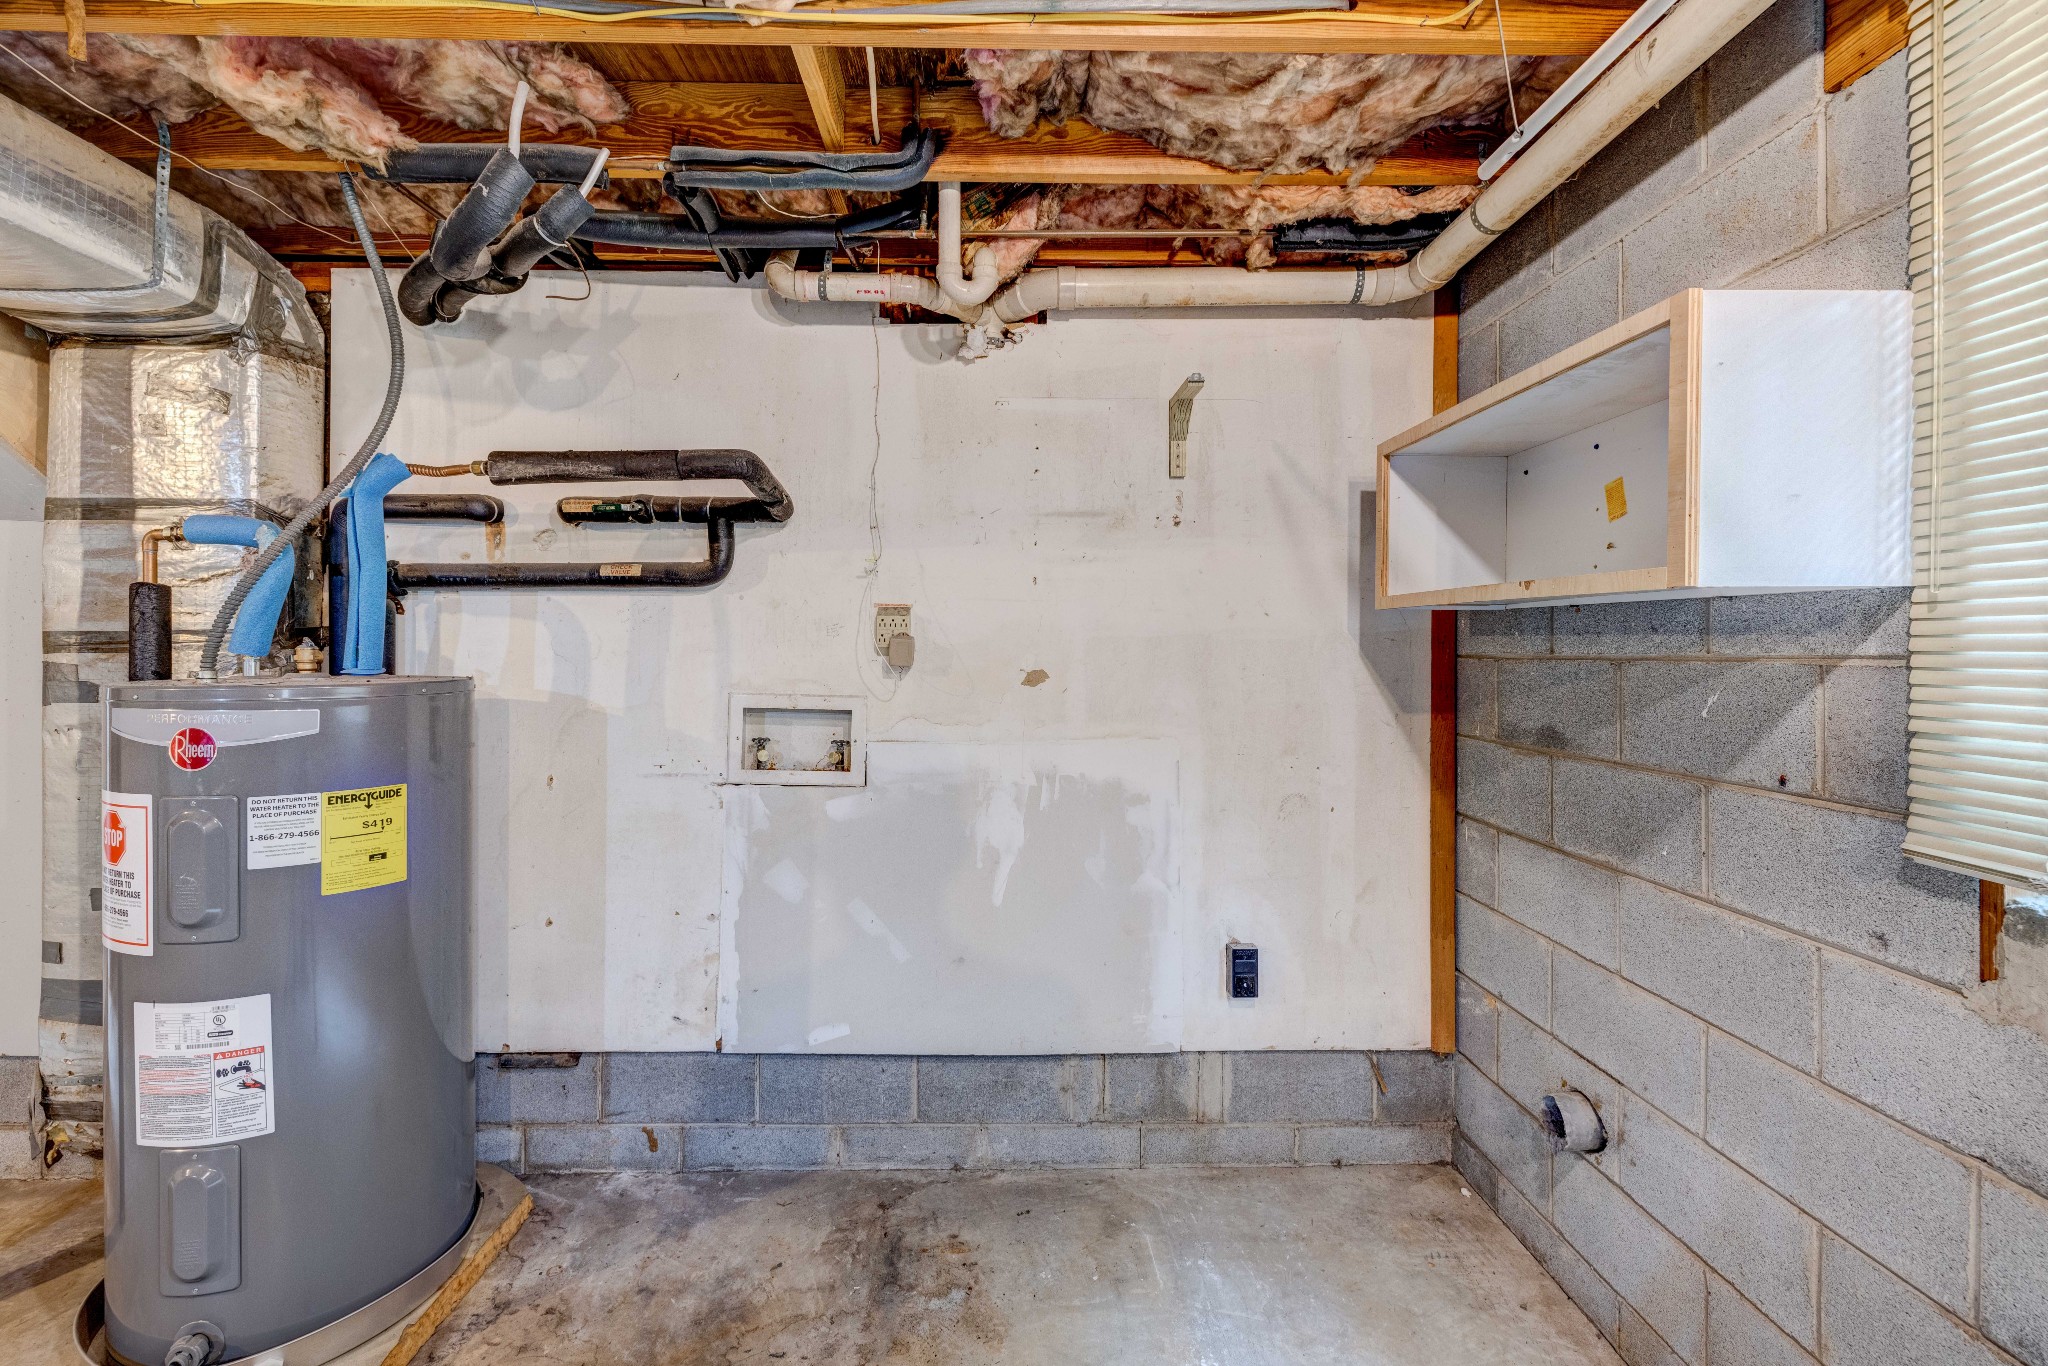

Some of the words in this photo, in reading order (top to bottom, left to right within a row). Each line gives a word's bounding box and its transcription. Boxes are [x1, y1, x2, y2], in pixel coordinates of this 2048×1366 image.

[146, 713, 253, 725] PERFORMANCE
[174, 728, 214, 764] Rheem
[327, 788, 402, 806] ENERGYGUIDE
[283, 808, 317, 817] PURCHASE
[104, 827, 123, 848] STOP
[249, 829, 320, 842] 1-866-279-4566
[123, 871, 135, 881] THIS
[125, 880, 132, 889] TO
[115, 888, 141, 900] PURCHASE
[225, 1047, 262, 1059] DANGER
